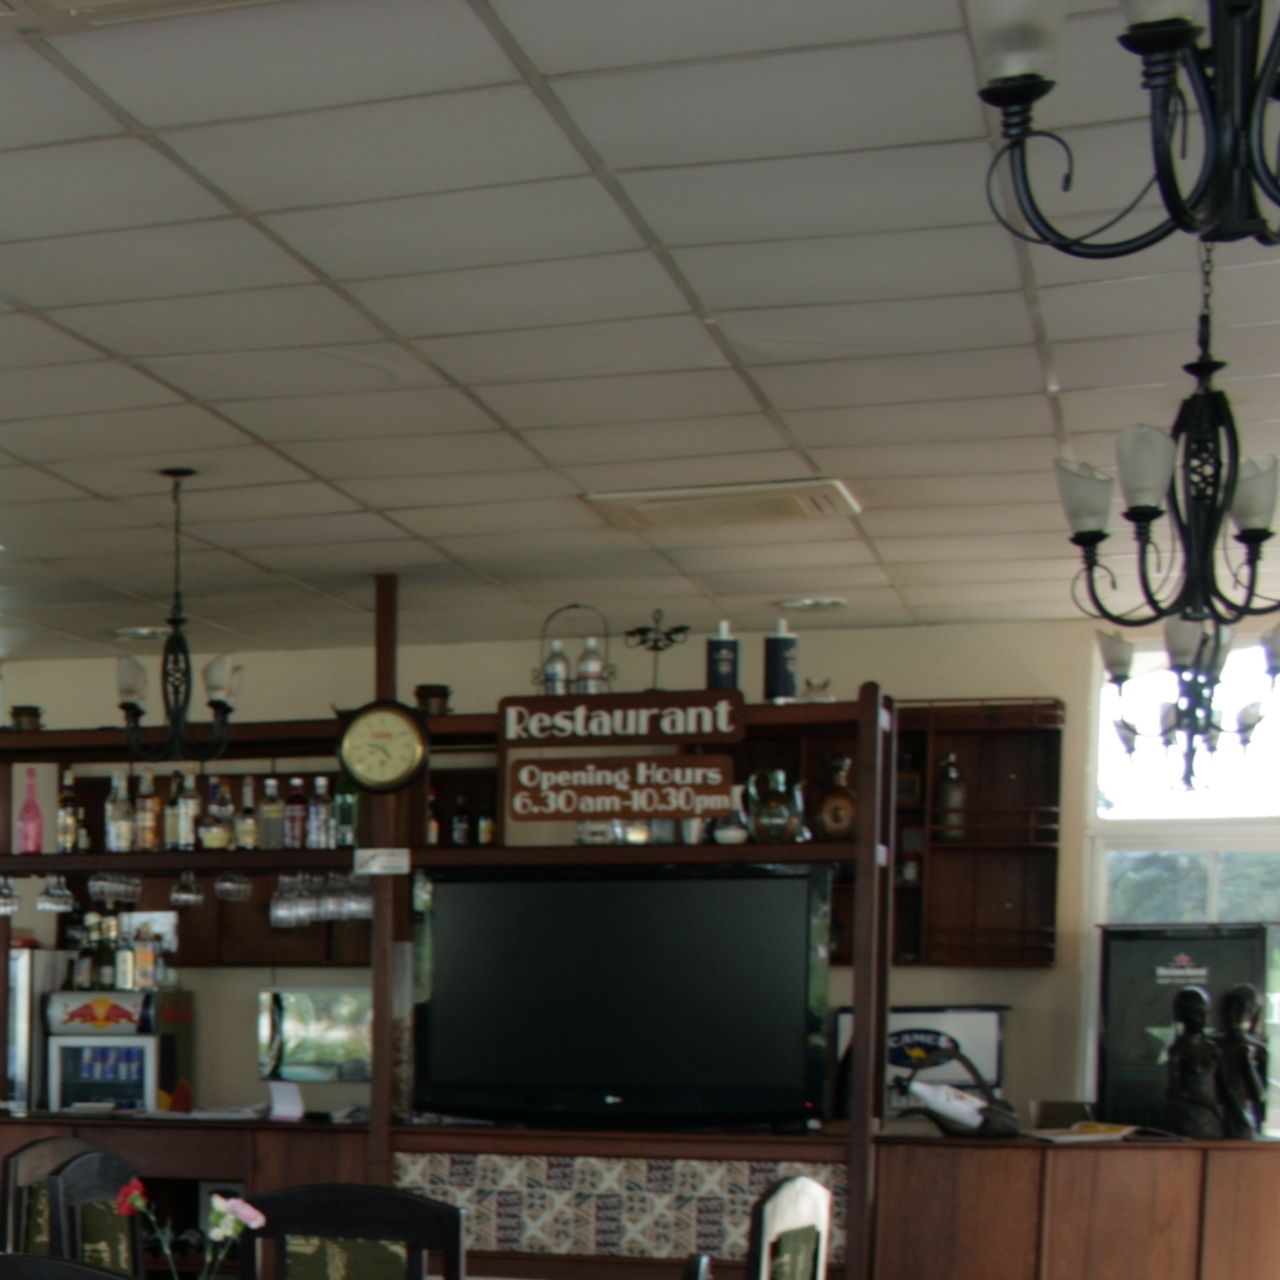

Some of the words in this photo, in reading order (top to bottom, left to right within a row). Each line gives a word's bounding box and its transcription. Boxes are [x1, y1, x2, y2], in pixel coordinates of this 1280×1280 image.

[505, 701, 734, 739] Restaurant
[519, 765, 630, 791] Opening
[637, 762, 723, 785] Hours
[512, 787, 730, 814] 6.30am-10.30pm
